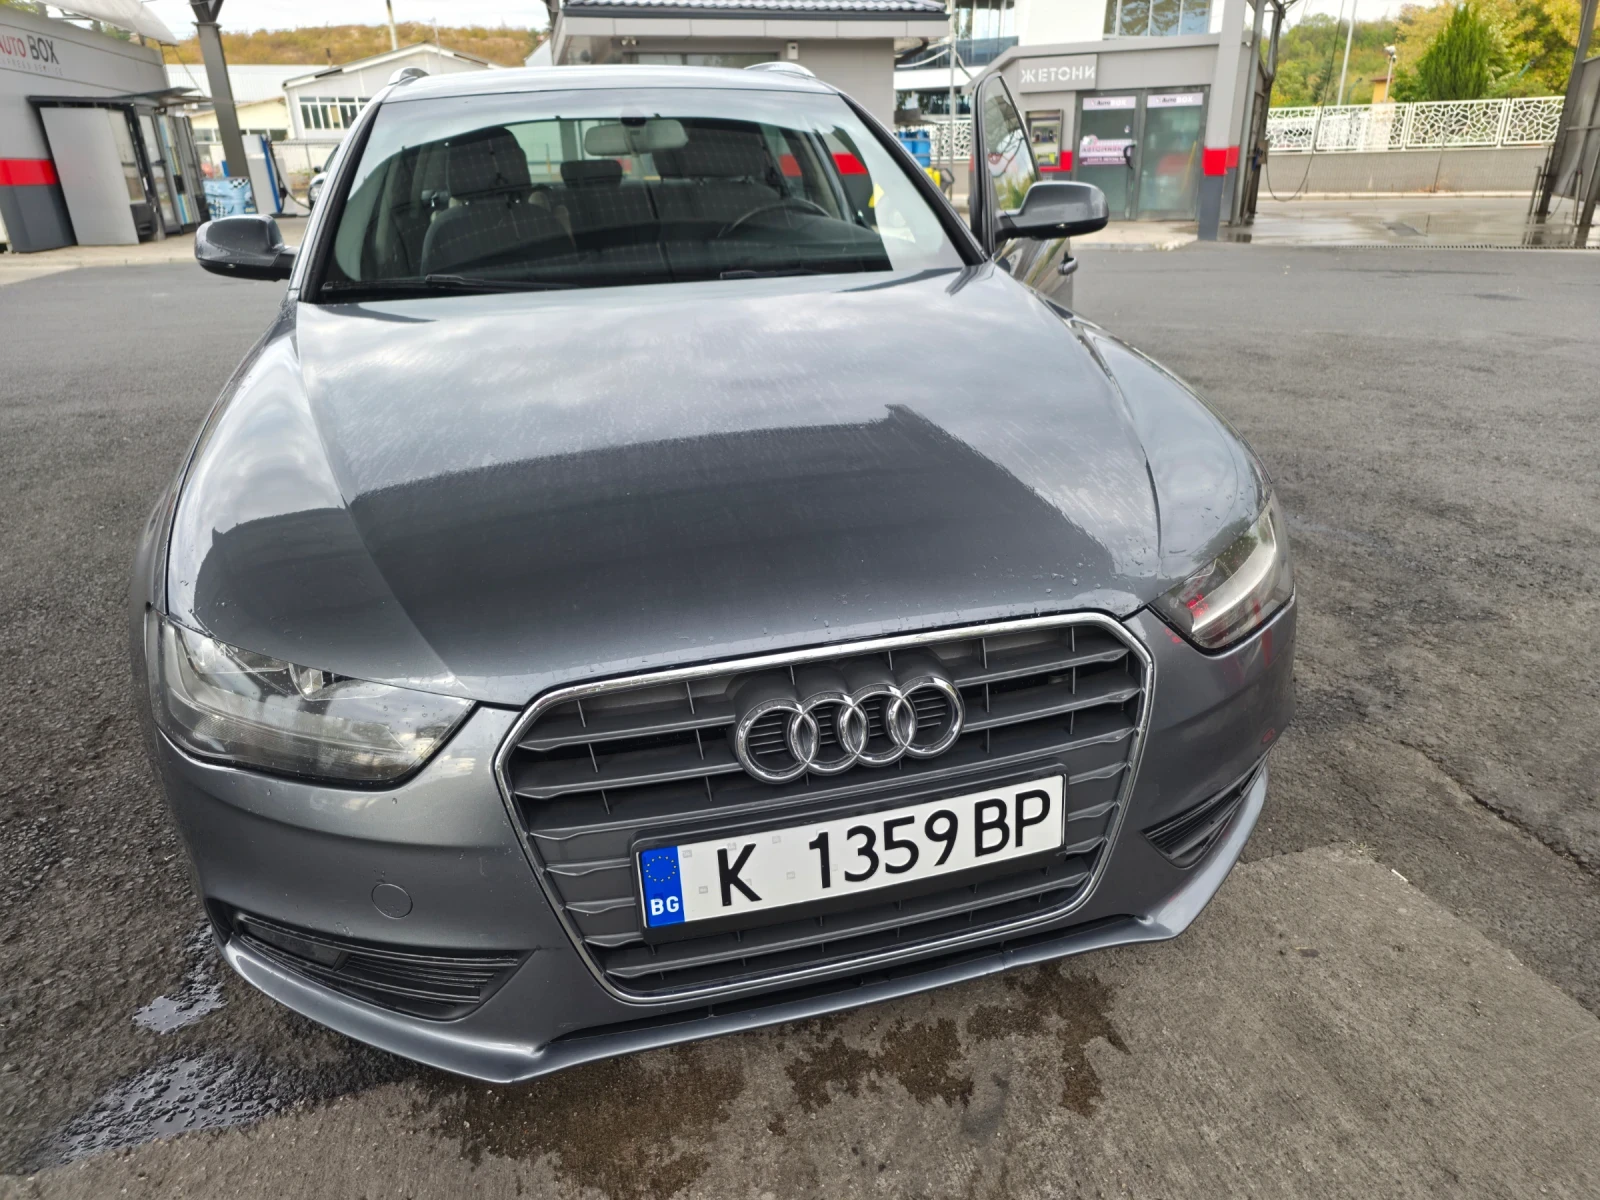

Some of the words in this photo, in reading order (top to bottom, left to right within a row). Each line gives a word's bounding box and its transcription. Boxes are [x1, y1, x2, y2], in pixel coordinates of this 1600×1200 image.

[26, 34, 60, 65] BOX
[1020, 65, 1095, 84] ЖЕТОНИ
[716, 843, 762, 907] K
[808, 809, 959, 890] 1359
[973, 789, 1051, 858] BP
[650, 896, 680, 916] BG
